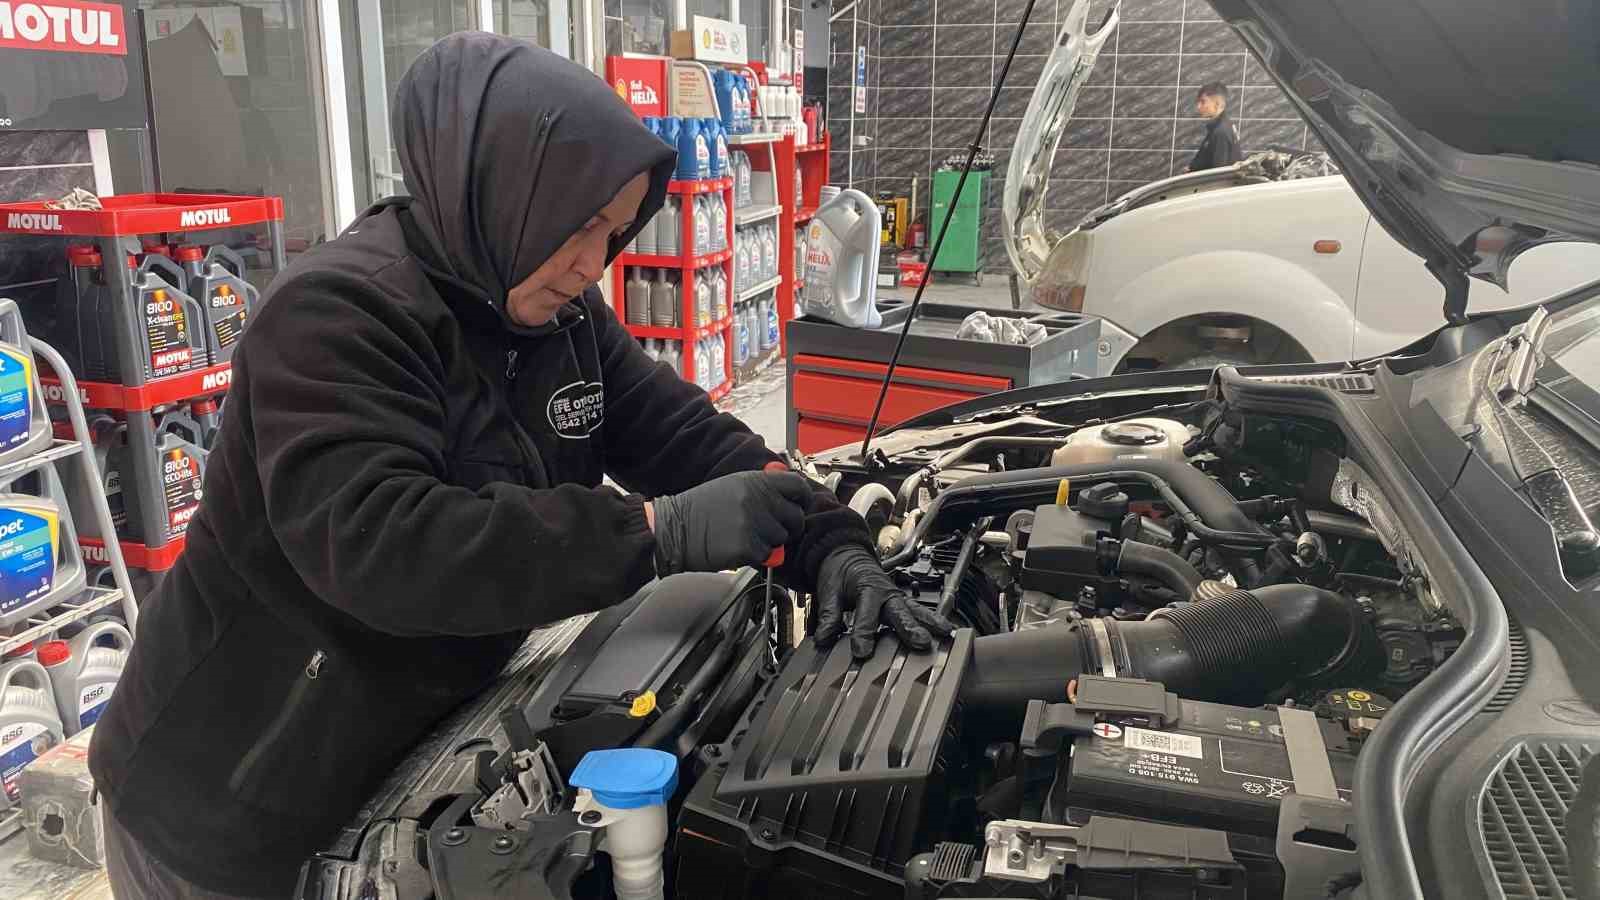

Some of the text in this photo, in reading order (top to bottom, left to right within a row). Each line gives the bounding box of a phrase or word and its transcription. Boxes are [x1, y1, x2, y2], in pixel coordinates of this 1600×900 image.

[8, 213, 63, 231] MOTUL
[181, 208, 231, 227] MOTUL
[146, 300, 173, 314] 8100
[212, 294, 236, 307] 8100
[156, 351, 190, 367] MOTUL
[202, 368, 233, 390] MOT
[553, 402, 572, 414] EFE
[557, 418, 581, 430] 0542
[164, 457, 190, 474] 8100
[83, 686, 104, 704] BSG
[2, 726, 23, 745] BSG
